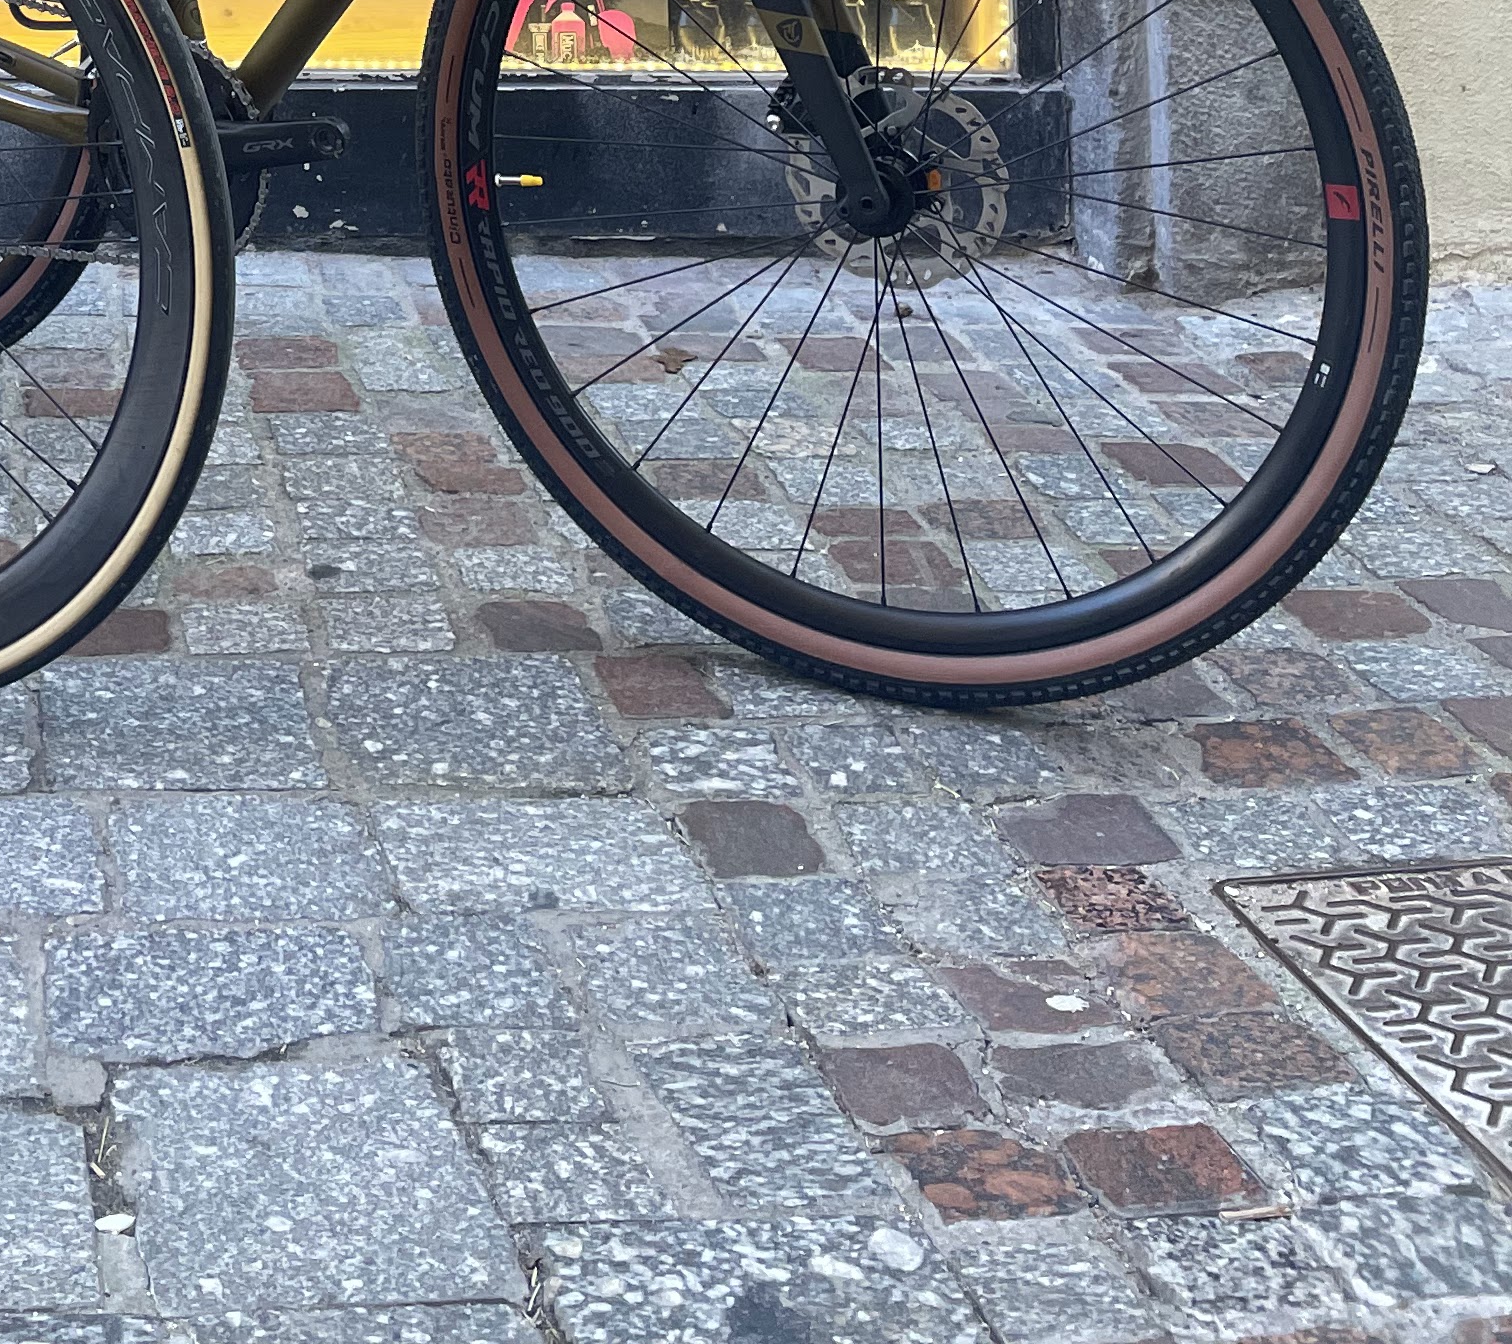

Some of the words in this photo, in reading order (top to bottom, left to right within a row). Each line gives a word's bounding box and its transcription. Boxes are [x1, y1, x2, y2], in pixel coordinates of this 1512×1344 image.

[243, 137, 294, 153] GRX
[445, 158, 463, 246] Cinturato
[1360, 146, 1386, 274] PIRELLI
